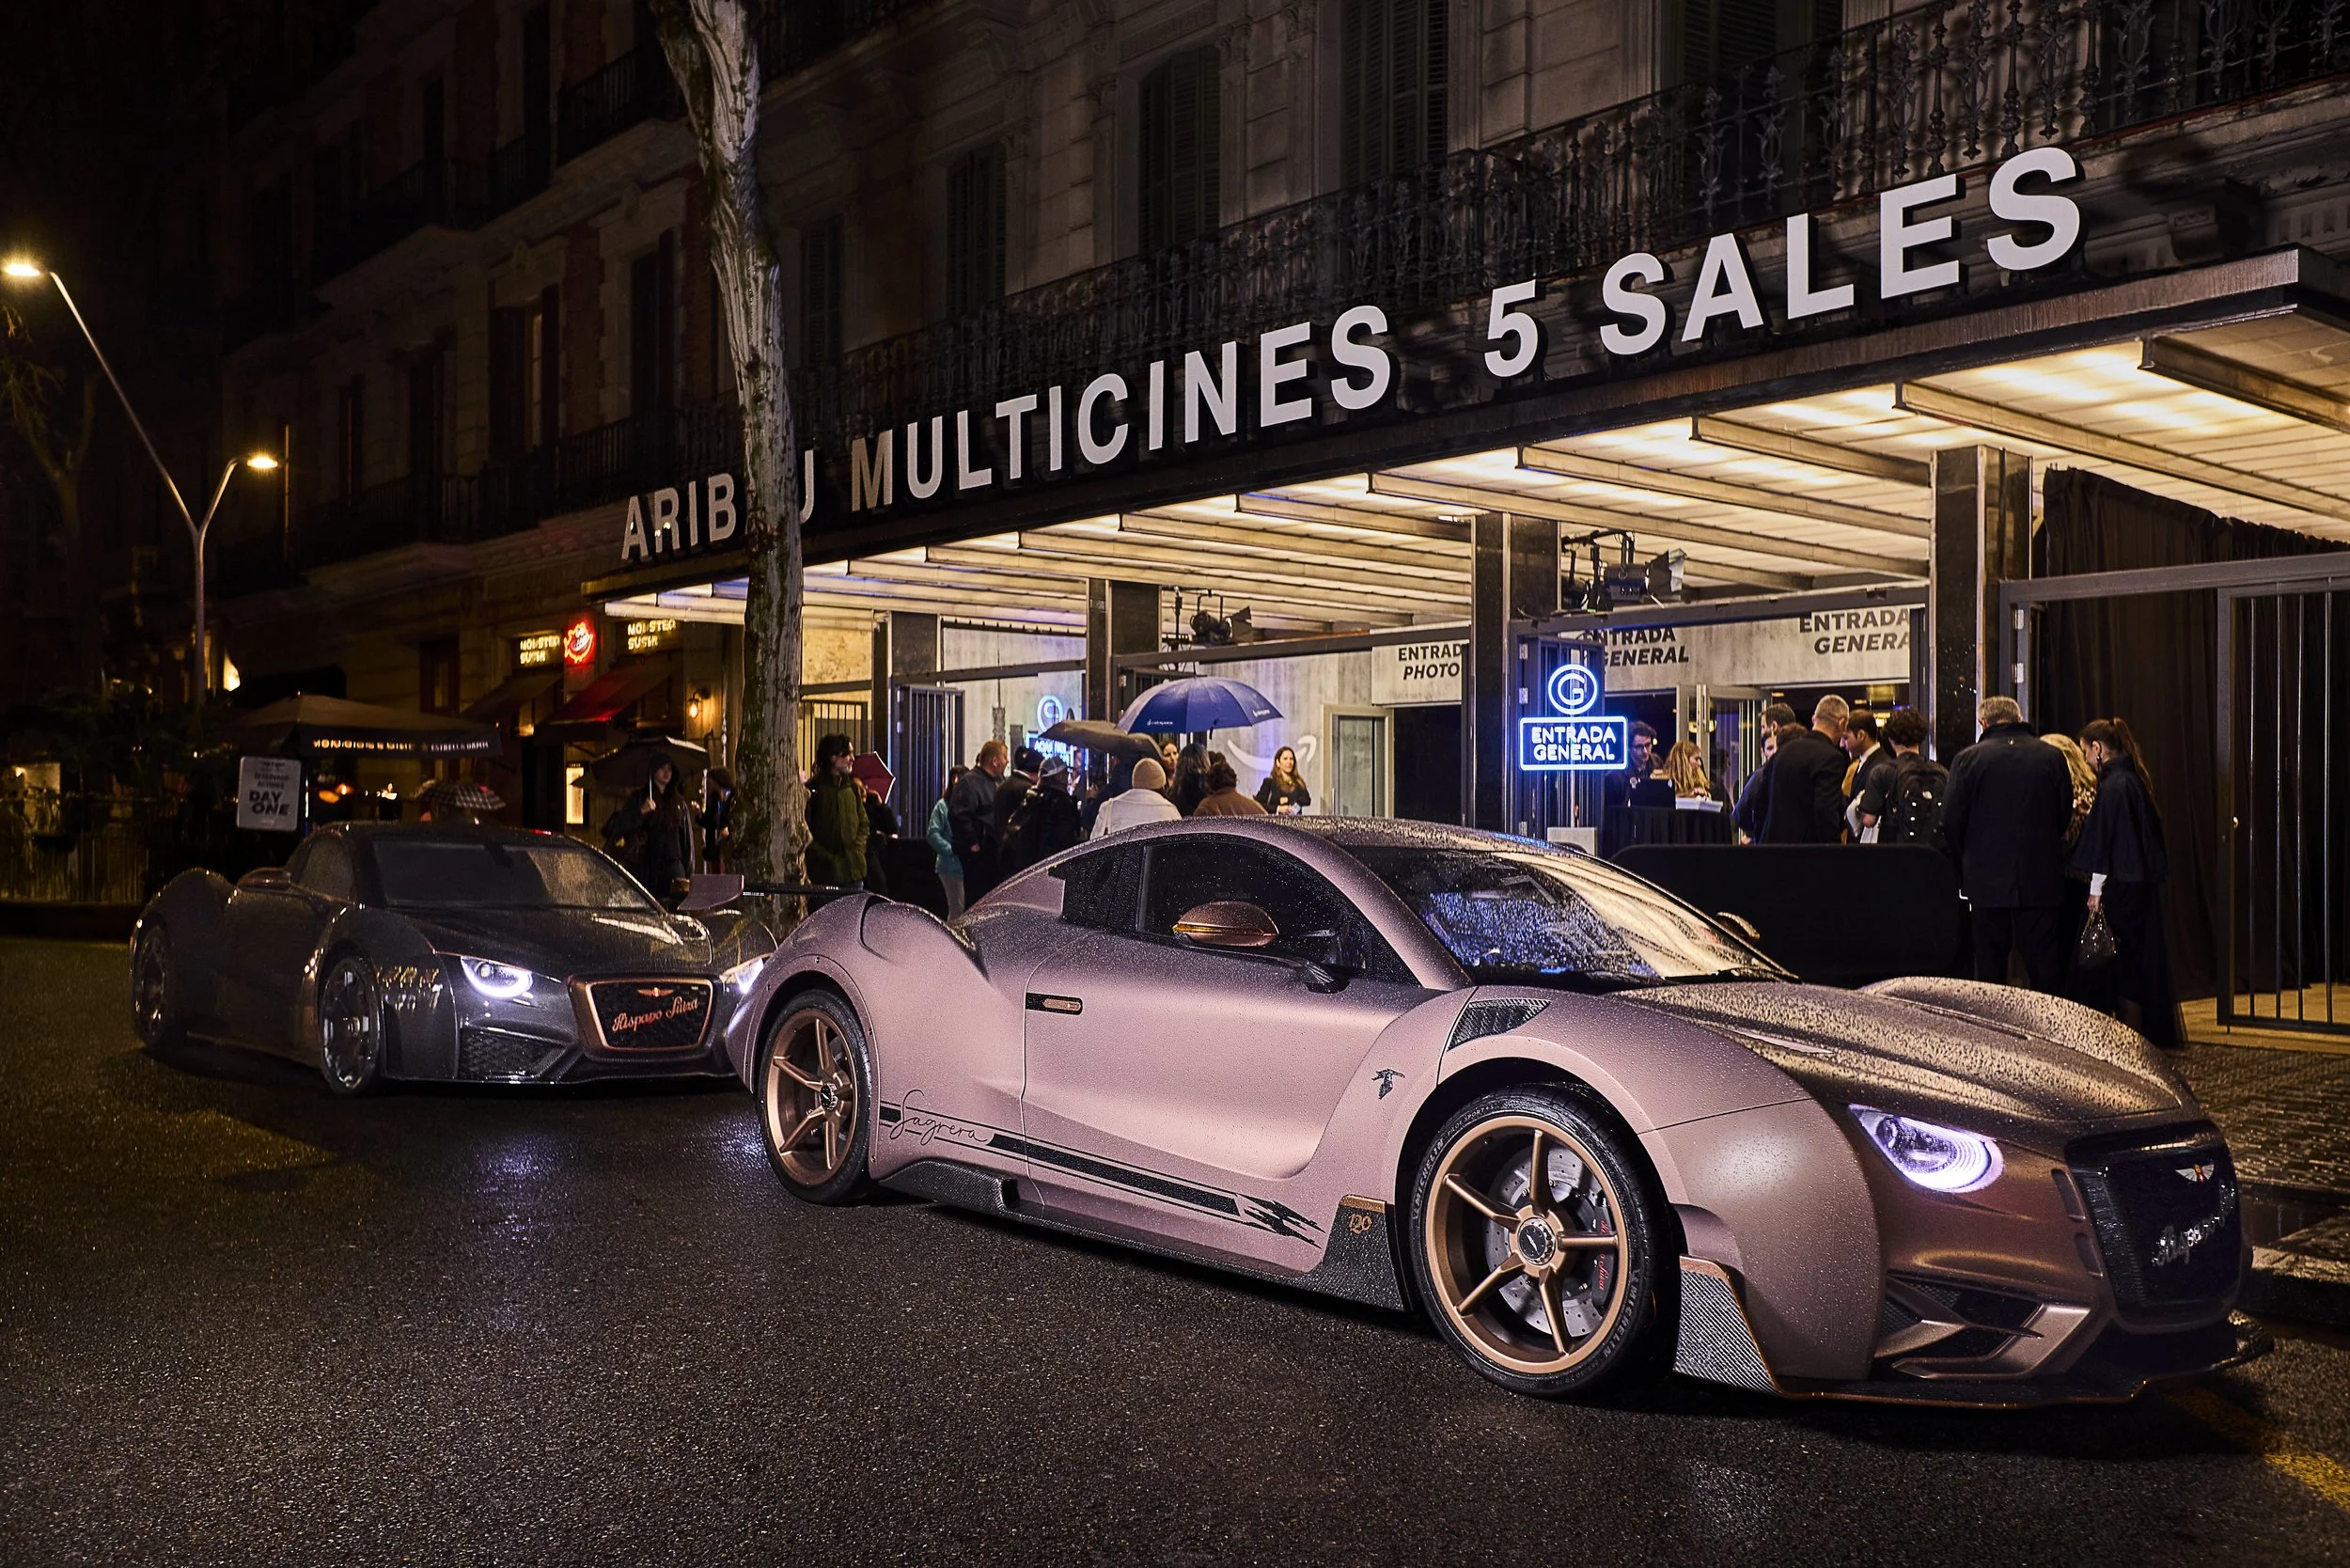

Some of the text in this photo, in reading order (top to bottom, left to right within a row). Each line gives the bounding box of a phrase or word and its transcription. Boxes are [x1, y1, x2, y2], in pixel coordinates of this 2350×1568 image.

[851, 306, 1391, 512] MULTICINES
[1484, 279, 1539, 378] 5
[1600, 147, 2081, 356] SALES
[1799, 608, 1909, 634] ENTRADA
[1403, 662, 1461, 681] PHOTO
[1531, 726, 1617, 744] ENTRADA
[1533, 744, 1616, 761] GENERAL
[249, 791, 283, 803] DAY
[252, 803, 290, 816] ONE
[889, 1089, 989, 1147] Sagrera
[1603, 1282, 1638, 1358] MICHELIN
